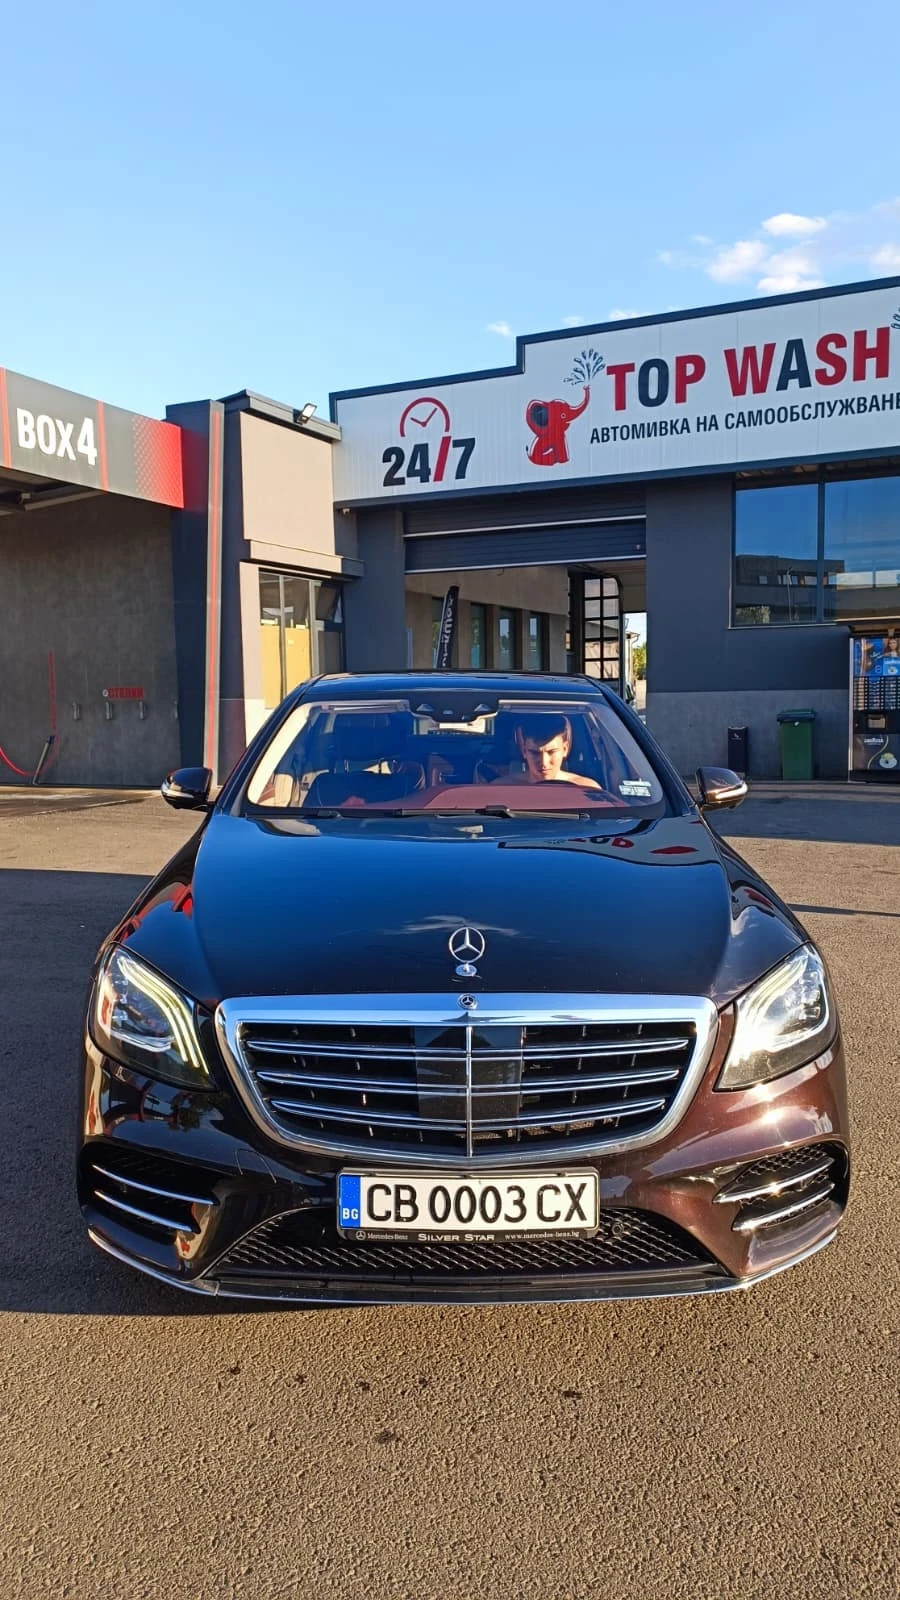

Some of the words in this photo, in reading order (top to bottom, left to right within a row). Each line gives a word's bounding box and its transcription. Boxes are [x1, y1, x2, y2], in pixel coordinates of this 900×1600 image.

[606, 354, 706, 412] TOP
[723, 326, 890, 397] WASH
[590, 415, 691, 445] АВТОМИВКА
[696, 414, 719, 433] НА
[381, 436, 476, 488] 24/7
[342, 1208, 359, 1220] BG
[428, 1184, 527, 1224] 0003
[418, 1233, 460, 1242] SILVER
[464, 1233, 495, 1242] STAR
